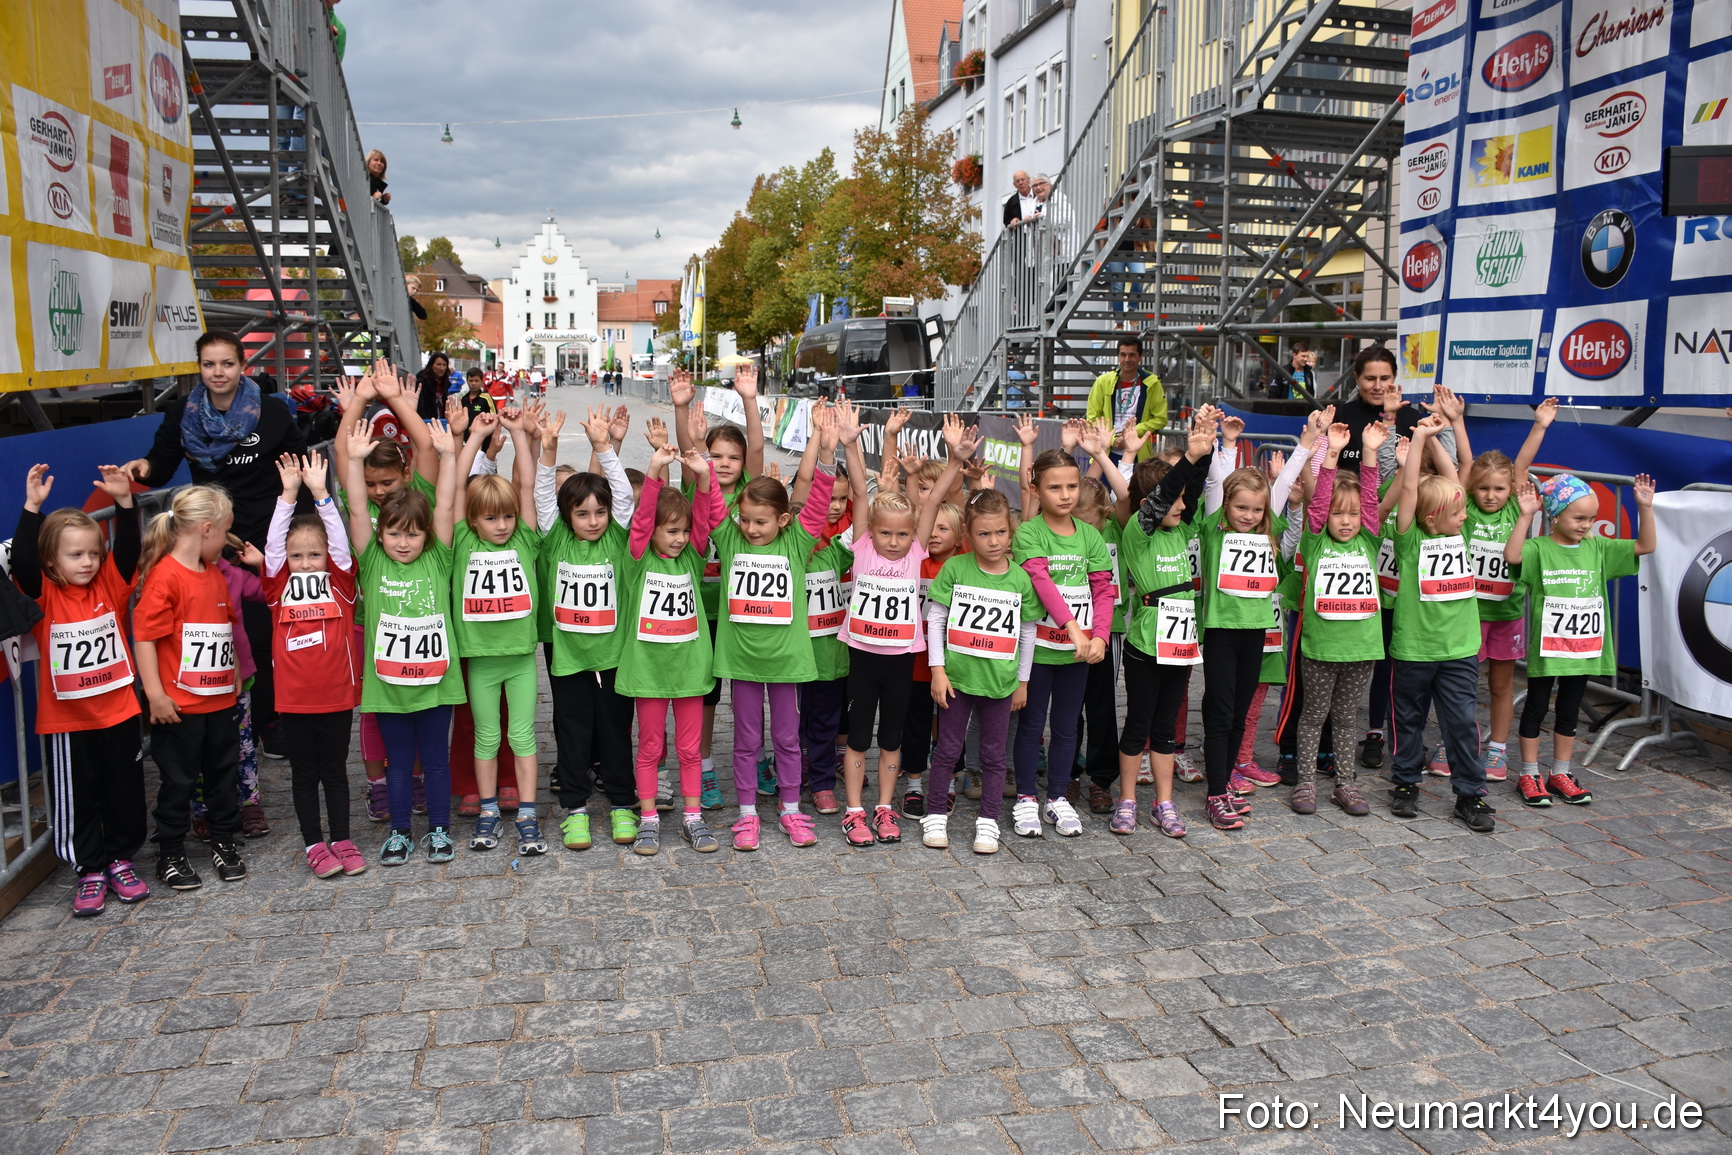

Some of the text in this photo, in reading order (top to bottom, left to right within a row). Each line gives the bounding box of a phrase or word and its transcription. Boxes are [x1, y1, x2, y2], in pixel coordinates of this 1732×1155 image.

[1423, 4, 1446, 26] DEHN
[1492, 43, 1549, 78] Hervis
[152, 64, 180, 106] Hervis
[1584, 100, 1633, 123] GERHART
[1584, 110, 1640, 130] Autohaus JANIG
[30, 117, 67, 144] GERHART
[1407, 150, 1443, 168] GERHART
[1601, 151, 1625, 169] KIA
[1517, 161, 1549, 178] KANN
[51, 190, 70, 211] KIA
[1422, 192, 1438, 206] KIA
[1586, 211, 1632, 240] BMW
[1480, 224, 1524, 258] RUND
[1406, 252, 1439, 278] Hervis
[1475, 256, 1527, 286] SCHAU
[51, 259, 80, 310] RUND
[155, 304, 197, 331] NATHUS
[52, 312, 85, 351] SCHAU
[1452, 344, 1528, 357] Neumarkter Tagblatt
[1568, 334, 1626, 366] Hervis
[1493, 361, 1505, 369] Hier
[1506, 361, 1519, 369] lebe
[1343, 450, 1360, 459] get
[485, 558, 515, 566] Neumarkt
[751, 561, 783, 570] Neumarkt
[1229, 548, 1274, 574] 7215
[1380, 552, 1399, 576] 74
[470, 567, 523, 594] 7415
[559, 569, 572, 578] PARTL
[1543, 577, 1581, 585] Stadtlauf
[646, 579, 665, 588] PARTL
[735, 571, 788, 598] 7029
[857, 581, 908, 593] PARTL Neumarkt
[1247, 579, 1260, 589] Ida
[1323, 572, 1372, 595] 7225
[1437, 581, 1470, 592] Johanna
[1475, 582, 1494, 592] Leni
[560, 580, 609, 607] 7101
[954, 590, 1012, 606] PARTL Neumarkt
[649, 589, 695, 617] 7438
[744, 603, 774, 615] Anouk
[858, 591, 910, 621] 7181
[1161, 605, 1184, 613] PARTL
[1318, 601, 1378, 611] Felicitas Klara
[1545, 602, 1569, 610] PARTL
[289, 606, 325, 620] Sophia
[574, 613, 590, 624] Eva
[817, 616, 838, 627] Fiona
[958, 602, 1015, 634] 7224
[51, 623, 109, 640] PARTL Neumarkt
[379, 620, 436, 631] PARTL Neumarkt
[656, 623, 686, 634] Emma
[864, 624, 899, 637] Madlen
[1551, 612, 1600, 635] 7420
[296, 637, 313, 646] DEHN
[384, 632, 443, 659] 7140
[969, 636, 994, 649] Julia
[57, 632, 118, 670] 7227
[78, 670, 113, 688] Janina
[401, 665, 424, 678] Anja
